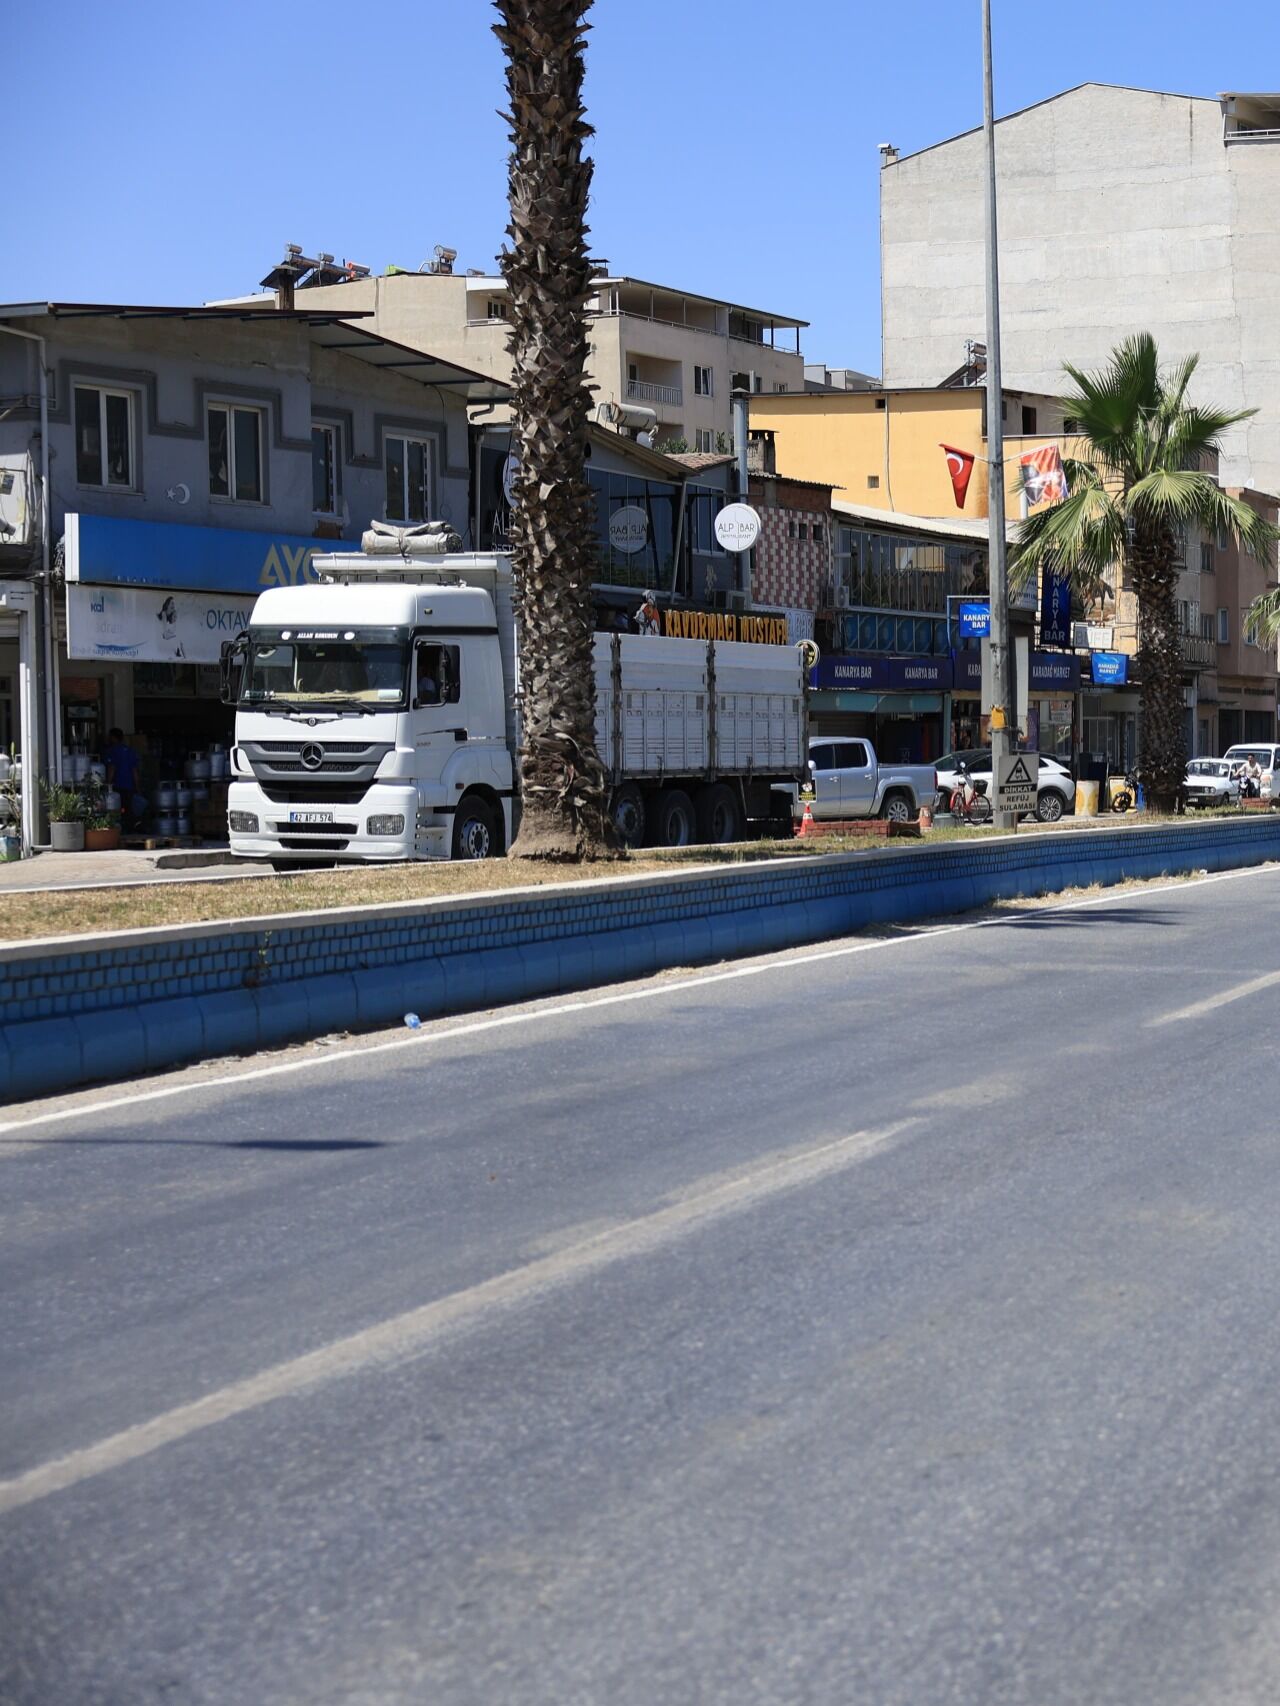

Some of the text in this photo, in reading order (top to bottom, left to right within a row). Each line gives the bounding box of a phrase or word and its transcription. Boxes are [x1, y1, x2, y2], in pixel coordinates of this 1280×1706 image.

[718, 523, 755, 533] ALP BAR
[1051, 574, 1061, 631] NARYA
[206, 609, 250, 630] OKTAY
[665, 609, 789, 645] KAVURMACI MUSTAFA
[1044, 631, 1065, 641] BAR
[834, 666, 872, 679] KANARYA BAR
[904, 667, 938, 680] KANARYA BAR
[967, 664, 981, 677] KARA
[1032, 664, 1070, 679] KARADAĞ MARKET
[1004, 785, 1033, 794] DİKKAT
[1006, 794, 1030, 803] REFÜJ
